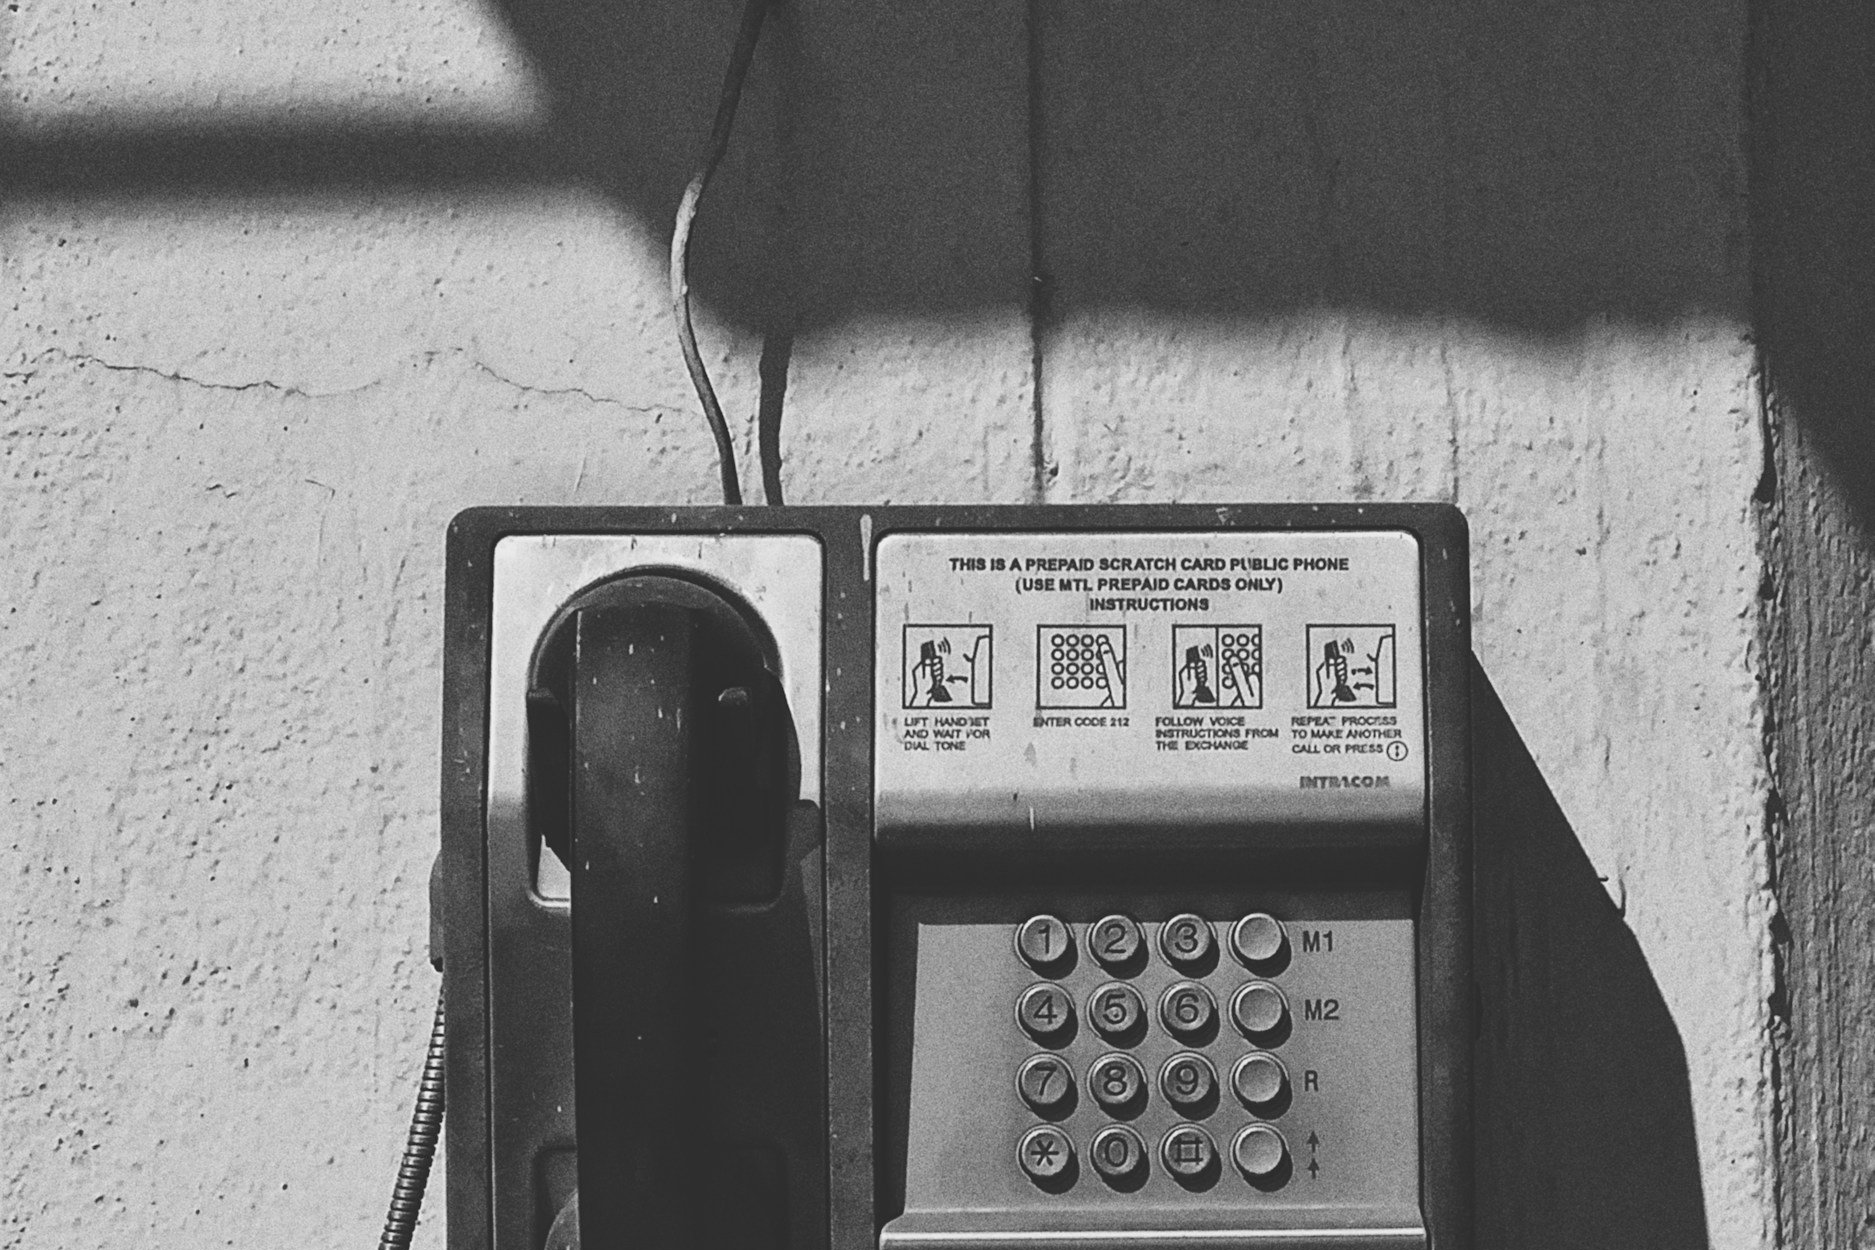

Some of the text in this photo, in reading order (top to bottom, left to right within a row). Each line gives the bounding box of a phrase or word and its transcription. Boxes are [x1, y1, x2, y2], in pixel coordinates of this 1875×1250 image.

[949, 558, 1348, 571] THIS IS A PREPAID SCRATCH CARD PUBLIC PHONE
[1016, 578, 1283, 594] (USE MTL PREPAID CARDS ONLY)
[1090, 598, 1209, 611] INSTRUCTIONS
[904, 717, 929, 727] LIFT
[1033, 717, 1130, 728] ENTER CODE 212
[1155, 717, 1245, 727] FOLLOW VOICE
[904, 729, 928, 739] AND
[933, 729, 961, 739] WAIT
[1156, 729, 1279, 739] INSTRUCTIONS FROM
[1292, 729, 1402, 739] TO MAKE ANOTHER
[904, 741, 966, 751] DIAL TONE
[1156, 740, 1249, 751] THE EXCHANGE
[1292, 744, 1384, 754] CALL OR PRESS
[1038, 925, 1051, 954] 1
[1104, 924, 1127, 954] 2
[1175, 923, 1198, 952] 3
[1303, 931, 1334, 953] M1
[1034, 995, 1057, 1025] 4
[1103, 994, 1127, 1024] 5
[1175, 993, 1199, 1024] 6
[1304, 999, 1340, 1021] M2
[1035, 1066, 1057, 1096] 7
[1104, 1065, 1127, 1096] 8
[1175, 1065, 1199, 1095] 9
[1304, 1071, 1319, 1092] R
[1105, 1137, 1129, 1168] 0
